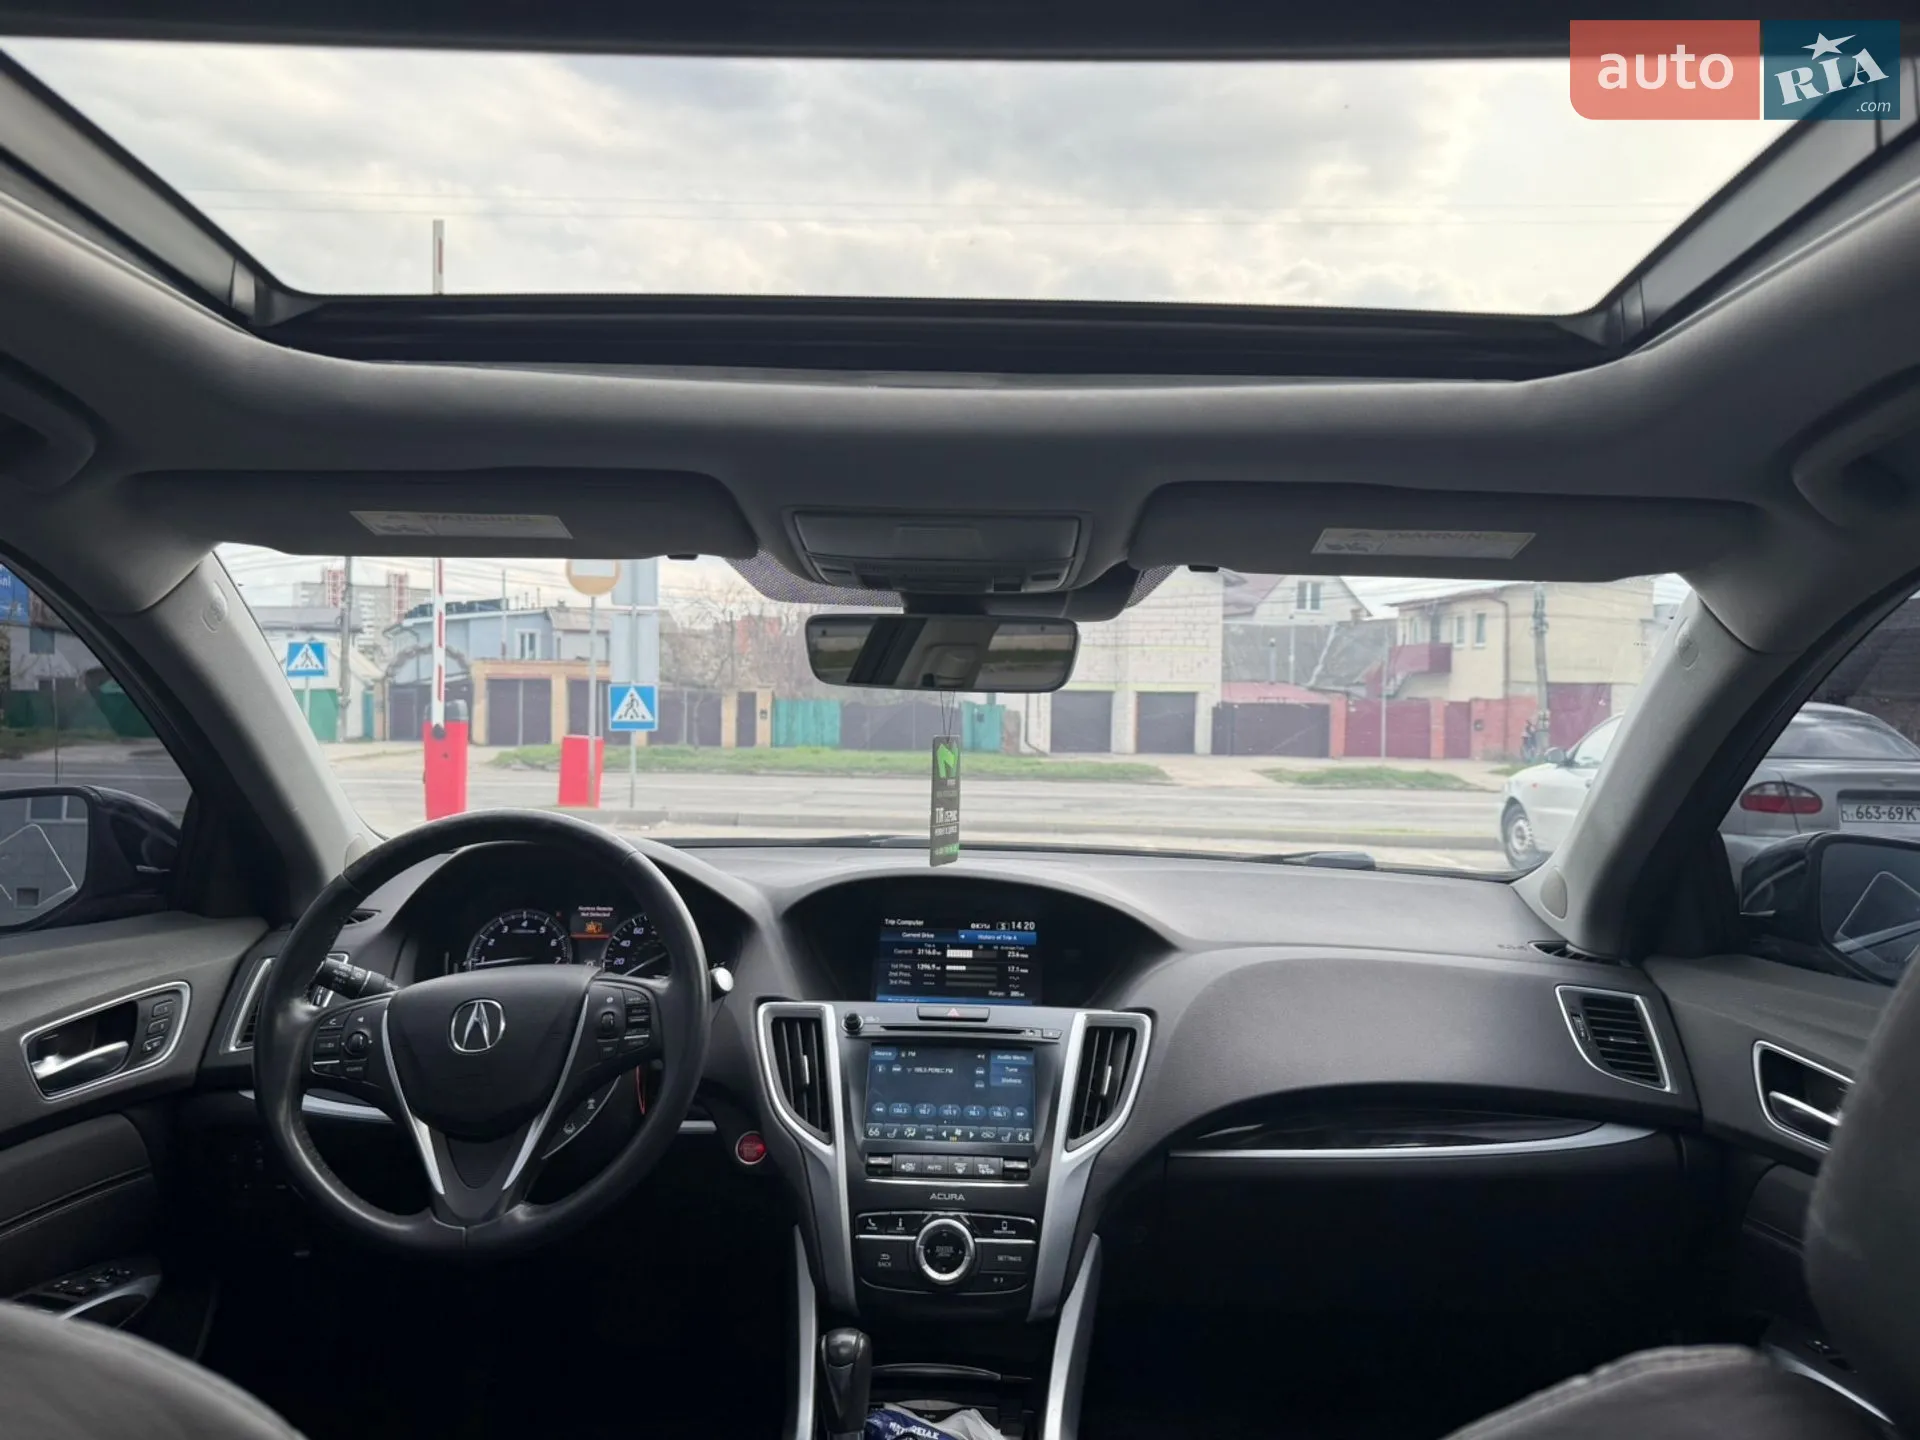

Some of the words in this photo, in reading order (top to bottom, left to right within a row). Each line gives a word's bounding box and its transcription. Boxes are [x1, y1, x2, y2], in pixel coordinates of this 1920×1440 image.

[896, 918, 924, 928] Computer
[868, 1128, 880, 1137] 66
[1018, 1132, 1030, 1142] 64
[929, 1193, 966, 1201] ACURA
